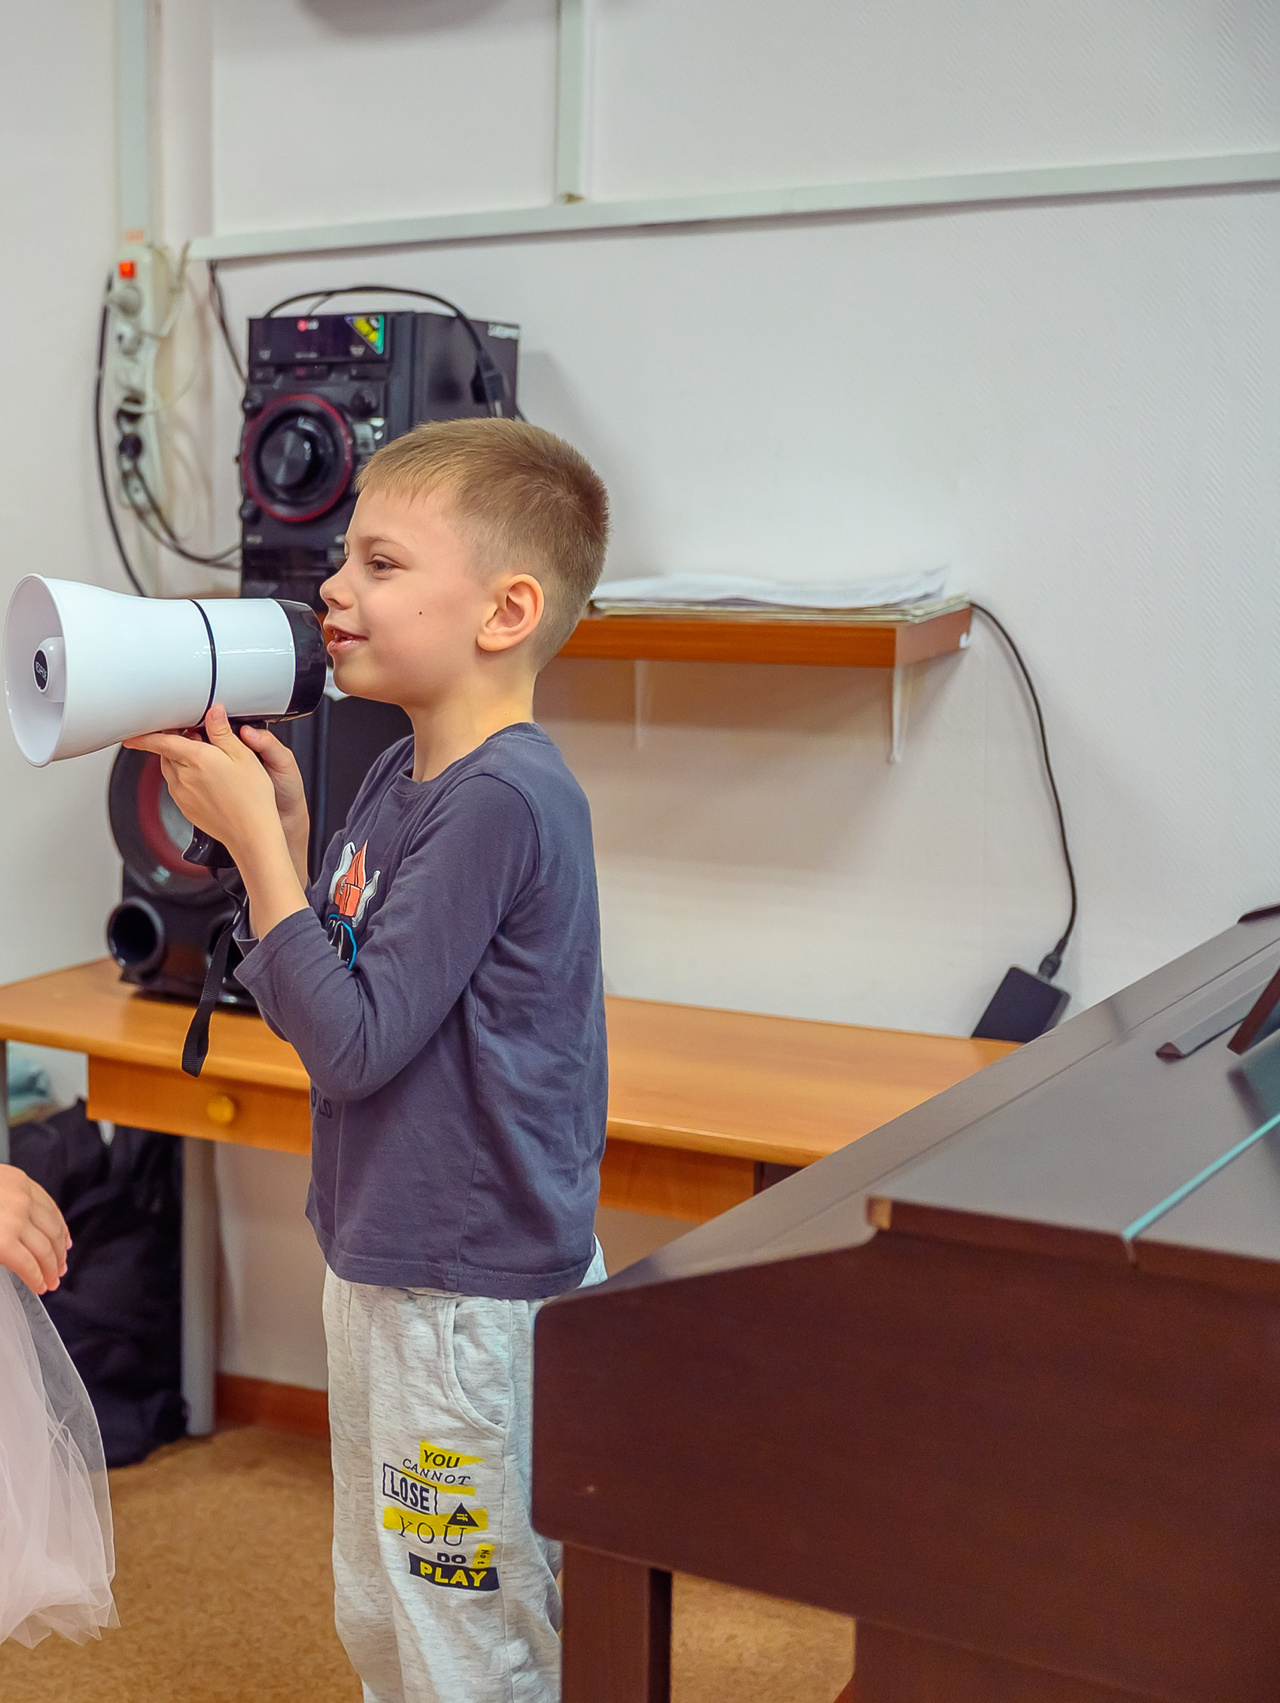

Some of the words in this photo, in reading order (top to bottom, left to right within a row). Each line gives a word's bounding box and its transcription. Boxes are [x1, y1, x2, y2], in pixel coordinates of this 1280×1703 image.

[402, 1458, 471, 1486] CANNOT
[423, 1449, 461, 1469] YOU
[390, 1471, 431, 1512] LOSE
[398, 1515, 467, 1546] YOU
[456, 1513, 469, 1522] if
[436, 1552, 467, 1564] DO
[420, 1561, 487, 1587] PLAY
